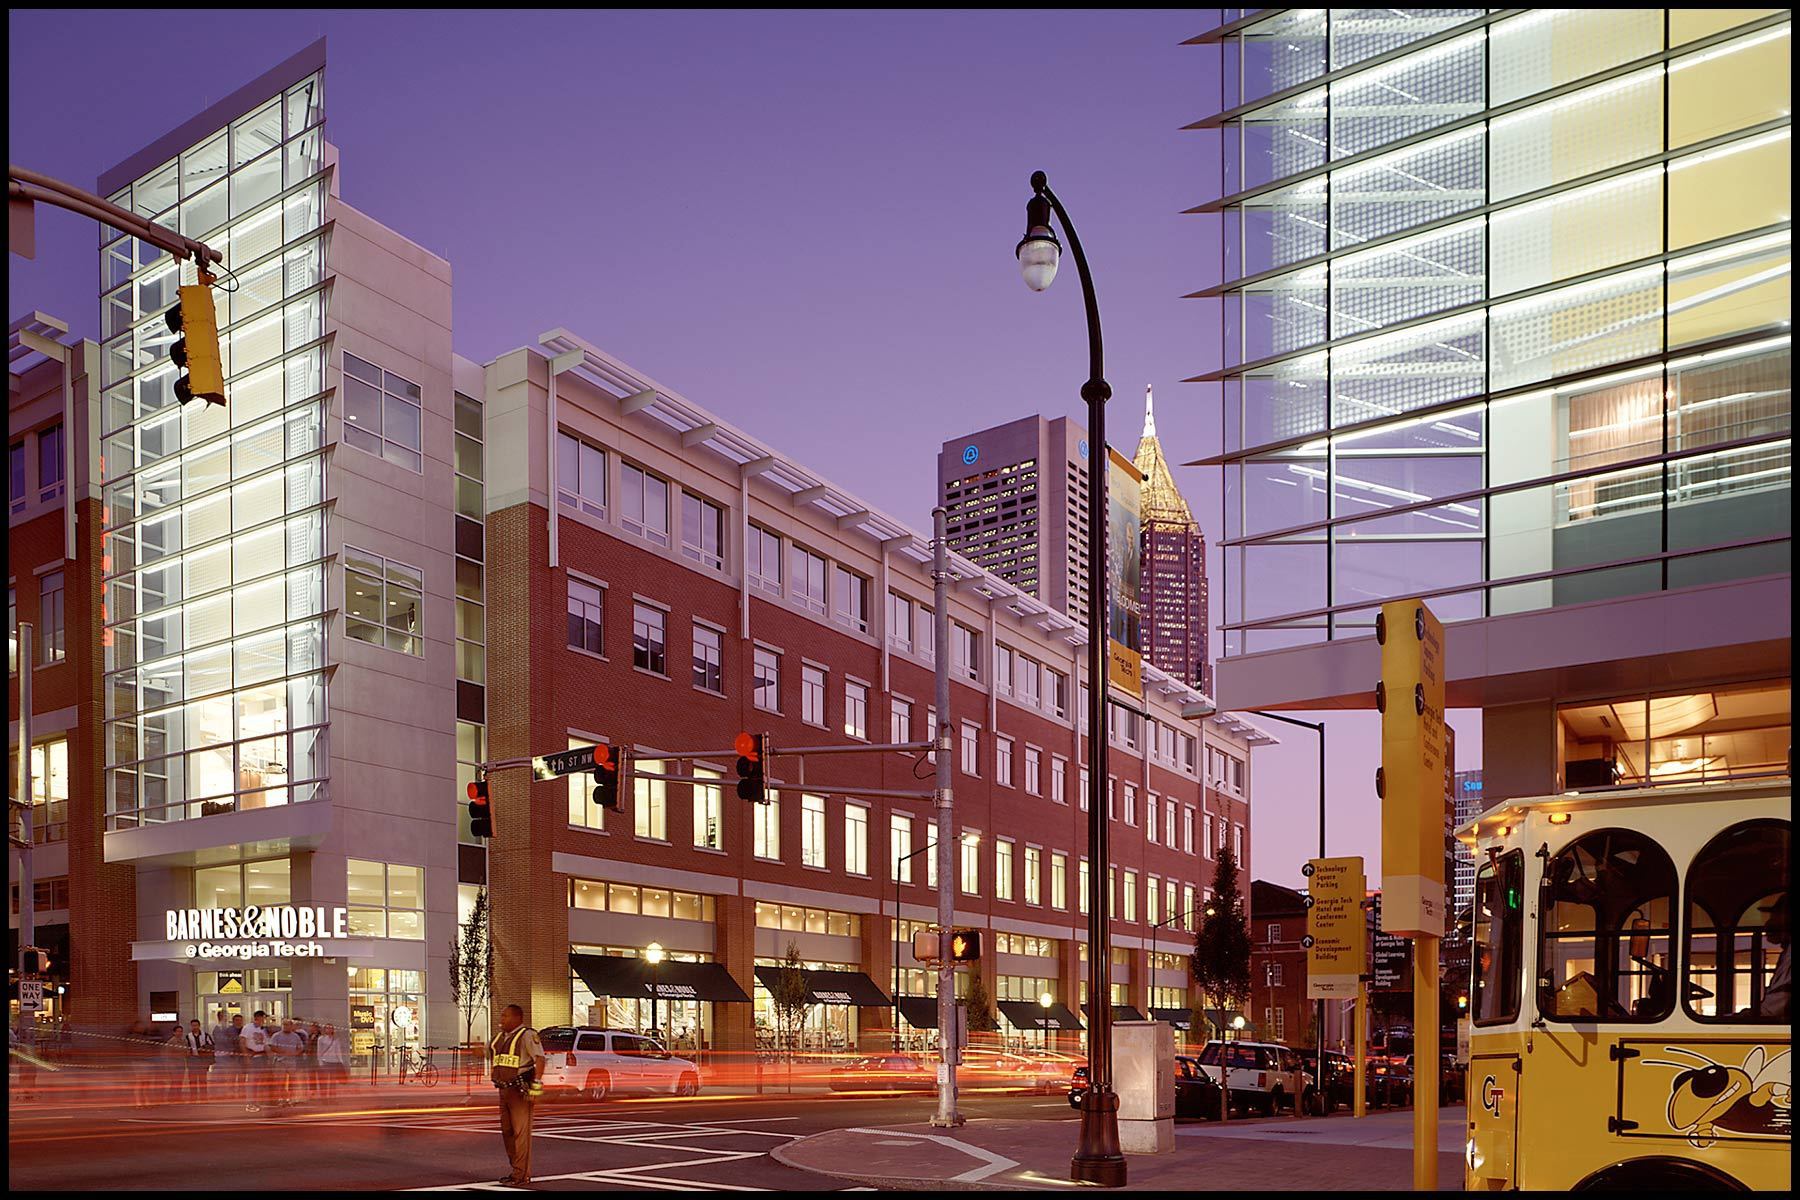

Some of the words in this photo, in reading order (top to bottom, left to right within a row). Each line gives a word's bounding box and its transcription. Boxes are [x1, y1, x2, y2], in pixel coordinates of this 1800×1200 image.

[568, 755, 578, 768] ST
[581, 753, 593, 765] NW
[1316, 865, 1347, 873] Technology
[1316, 874, 1336, 882] Square
[1316, 881, 1338, 889] Parking
[1340, 896, 1352, 904] Tech
[1333, 904, 1344, 912] and
[166, 907, 238, 941] BARNES
[265, 906, 348, 939] NOBLE
[185, 944, 197, 958] @
[198, 941, 269, 960] Georgia
[269, 941, 324, 957] Tech
[1315, 945, 1352, 953] Development
[1315, 953, 1337, 961] Building
[22, 983, 40, 991] ONE
[1482, 1074, 1504, 1118] GT
